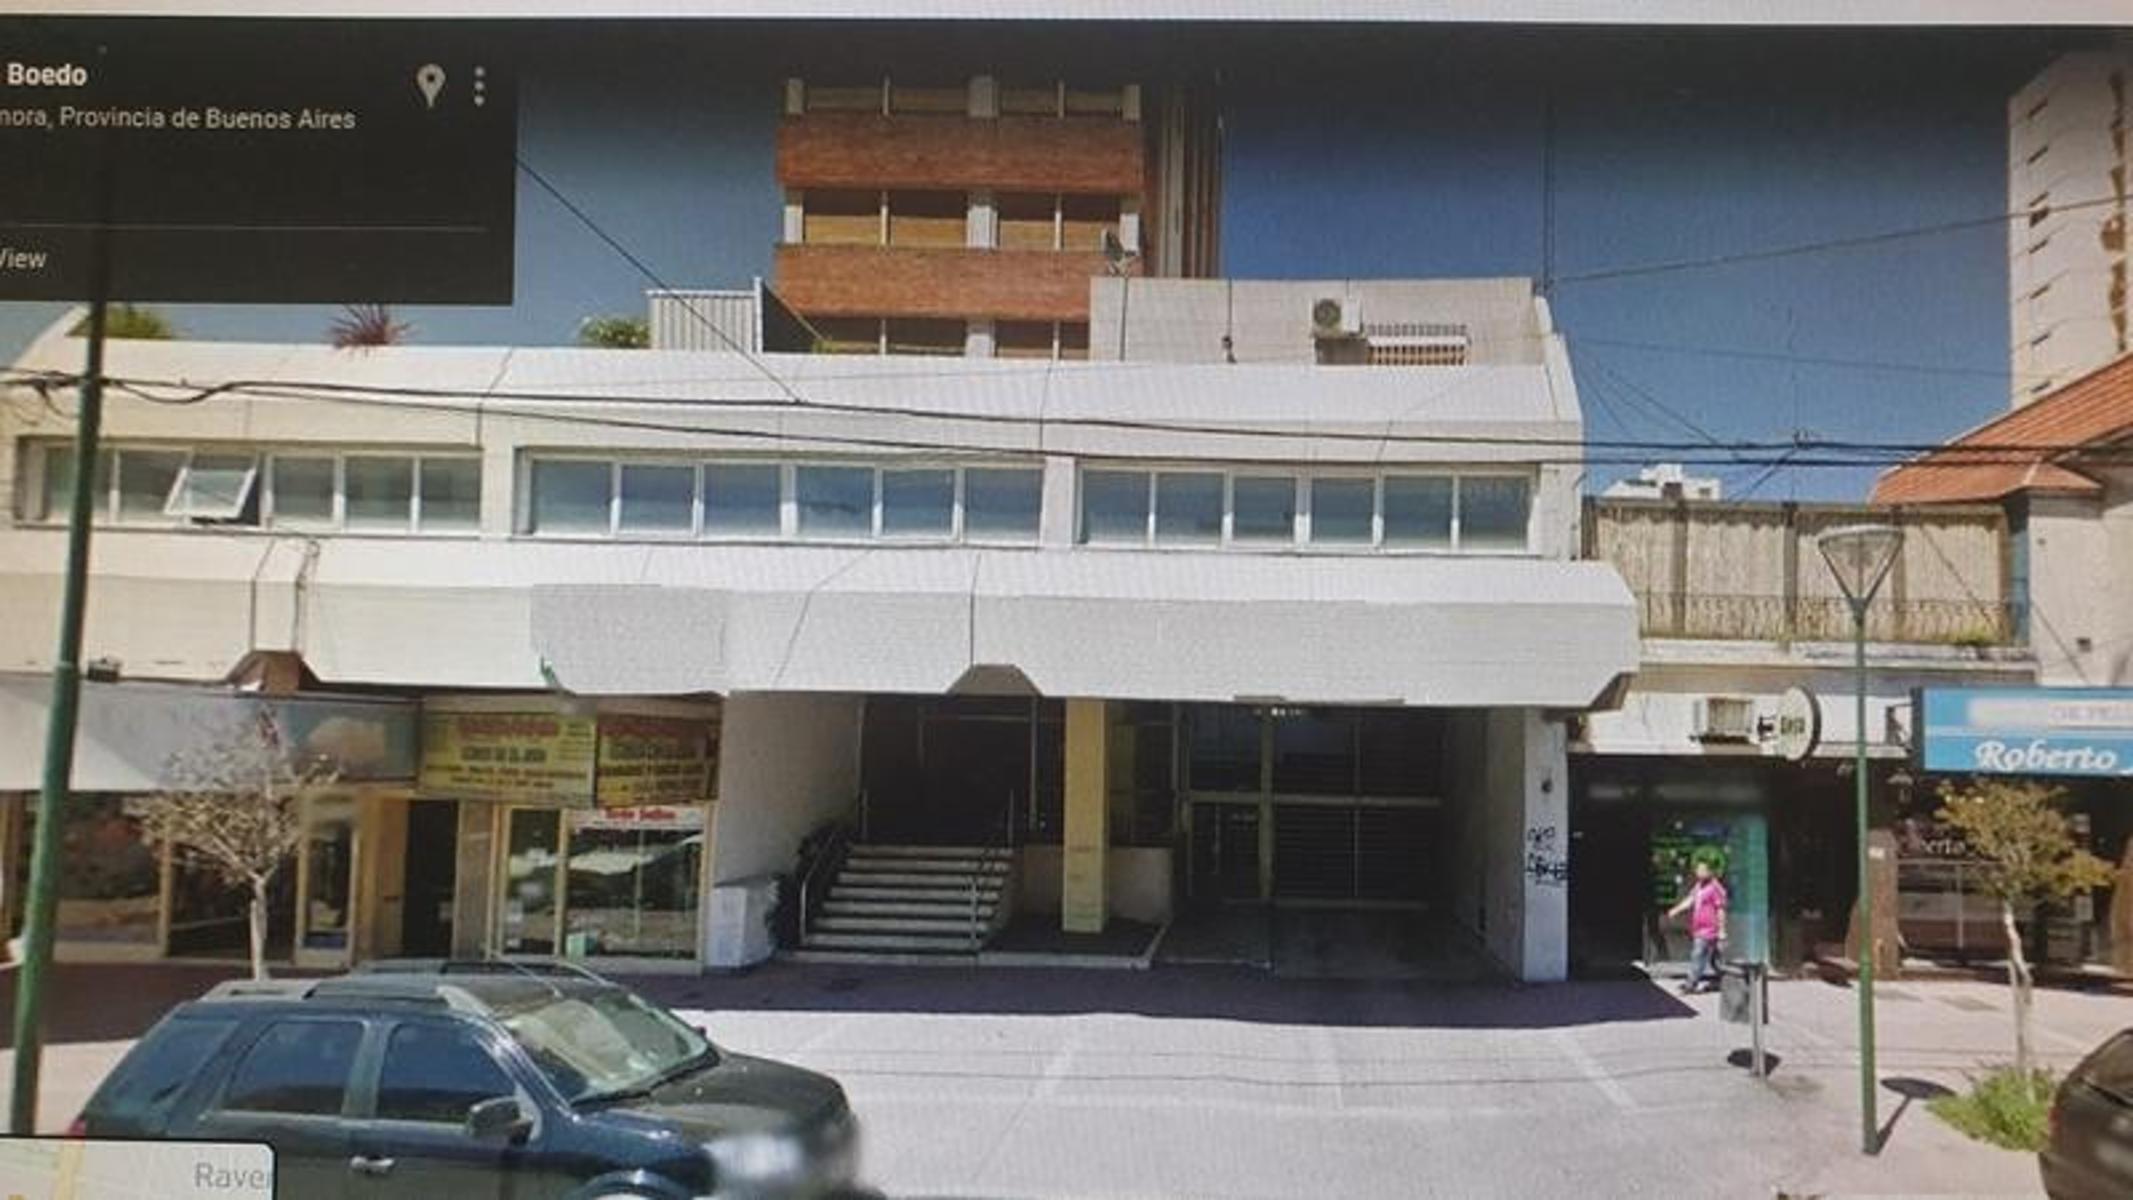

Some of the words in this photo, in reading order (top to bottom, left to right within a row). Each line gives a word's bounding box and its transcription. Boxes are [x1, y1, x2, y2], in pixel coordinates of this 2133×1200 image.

[7, 62, 88, 86] Boedo
[60, 105, 165, 128] Provincia
[171, 106, 200, 128] de
[205, 107, 292, 129] Buenos
[297, 108, 356, 129] Aires
[1974, 739, 2118, 772] Roberto
